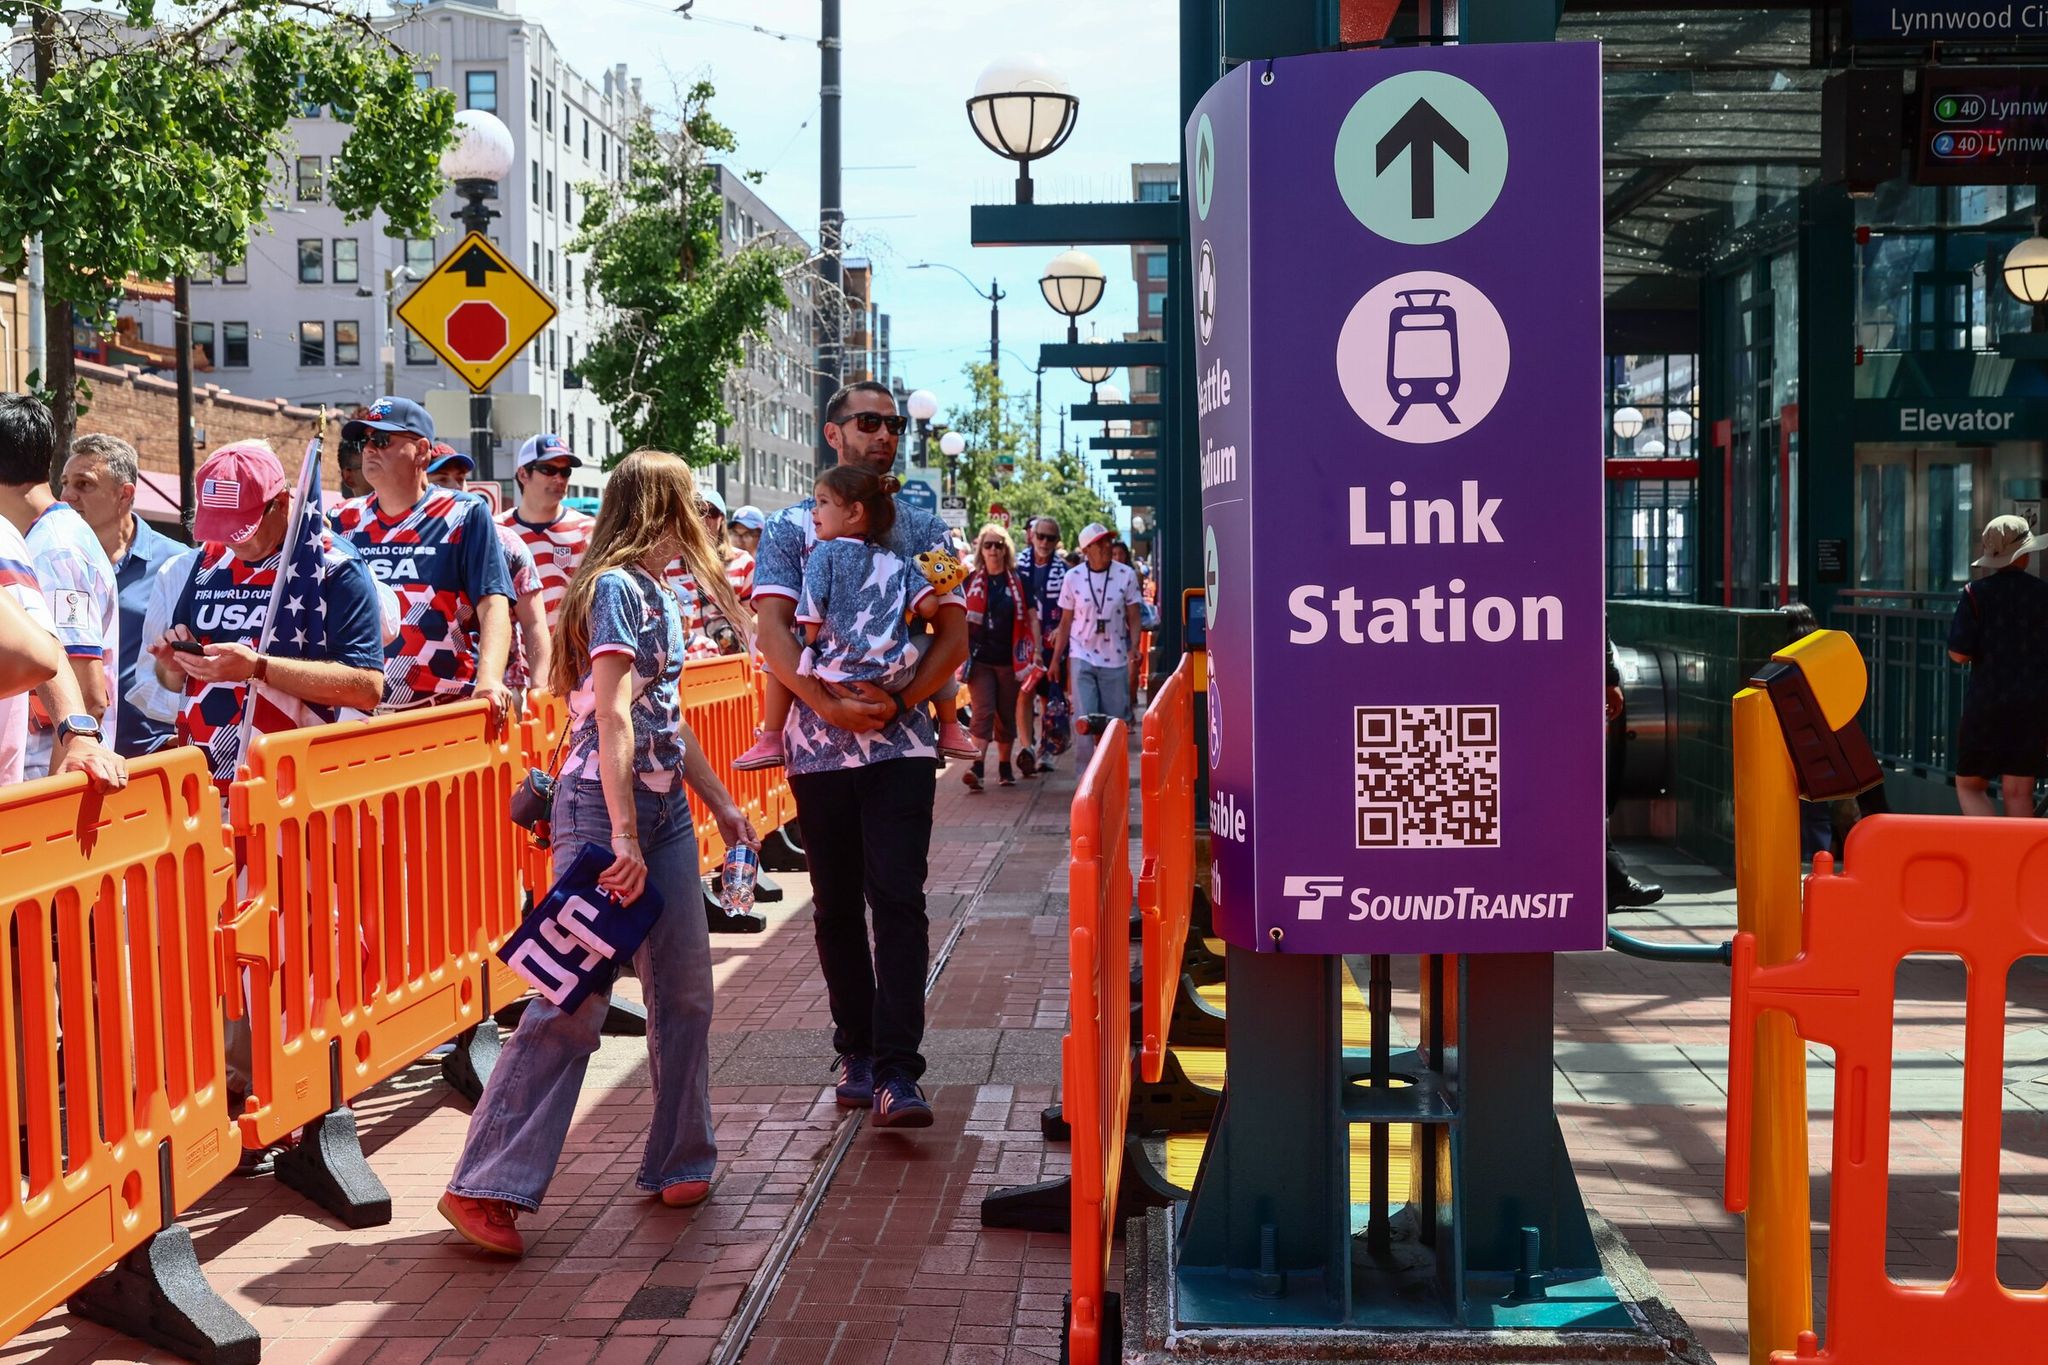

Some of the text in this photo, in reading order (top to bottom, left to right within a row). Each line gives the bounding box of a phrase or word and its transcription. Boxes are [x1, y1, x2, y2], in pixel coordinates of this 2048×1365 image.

[1891, 4, 2011, 36] Lynnwood
[1943, 102, 1951, 115] 1
[1961, 101, 1979, 116] 40
[1940, 136, 1950, 151] 2
[1958, 137, 1976, 151] 40
[1198, 358, 1231, 418] eattle
[1900, 408, 2014, 431] Elevator
[1201, 437, 1236, 490] adium
[1349, 480, 1505, 545] Link
[391, 546, 413, 555] CUP
[365, 558, 419, 580] SA
[195, 588, 272, 600] FIFA WORLD CUP
[196, 604, 269, 630] USA
[1288, 578, 1564, 645] Station
[1209, 790, 1246, 843] ssible
